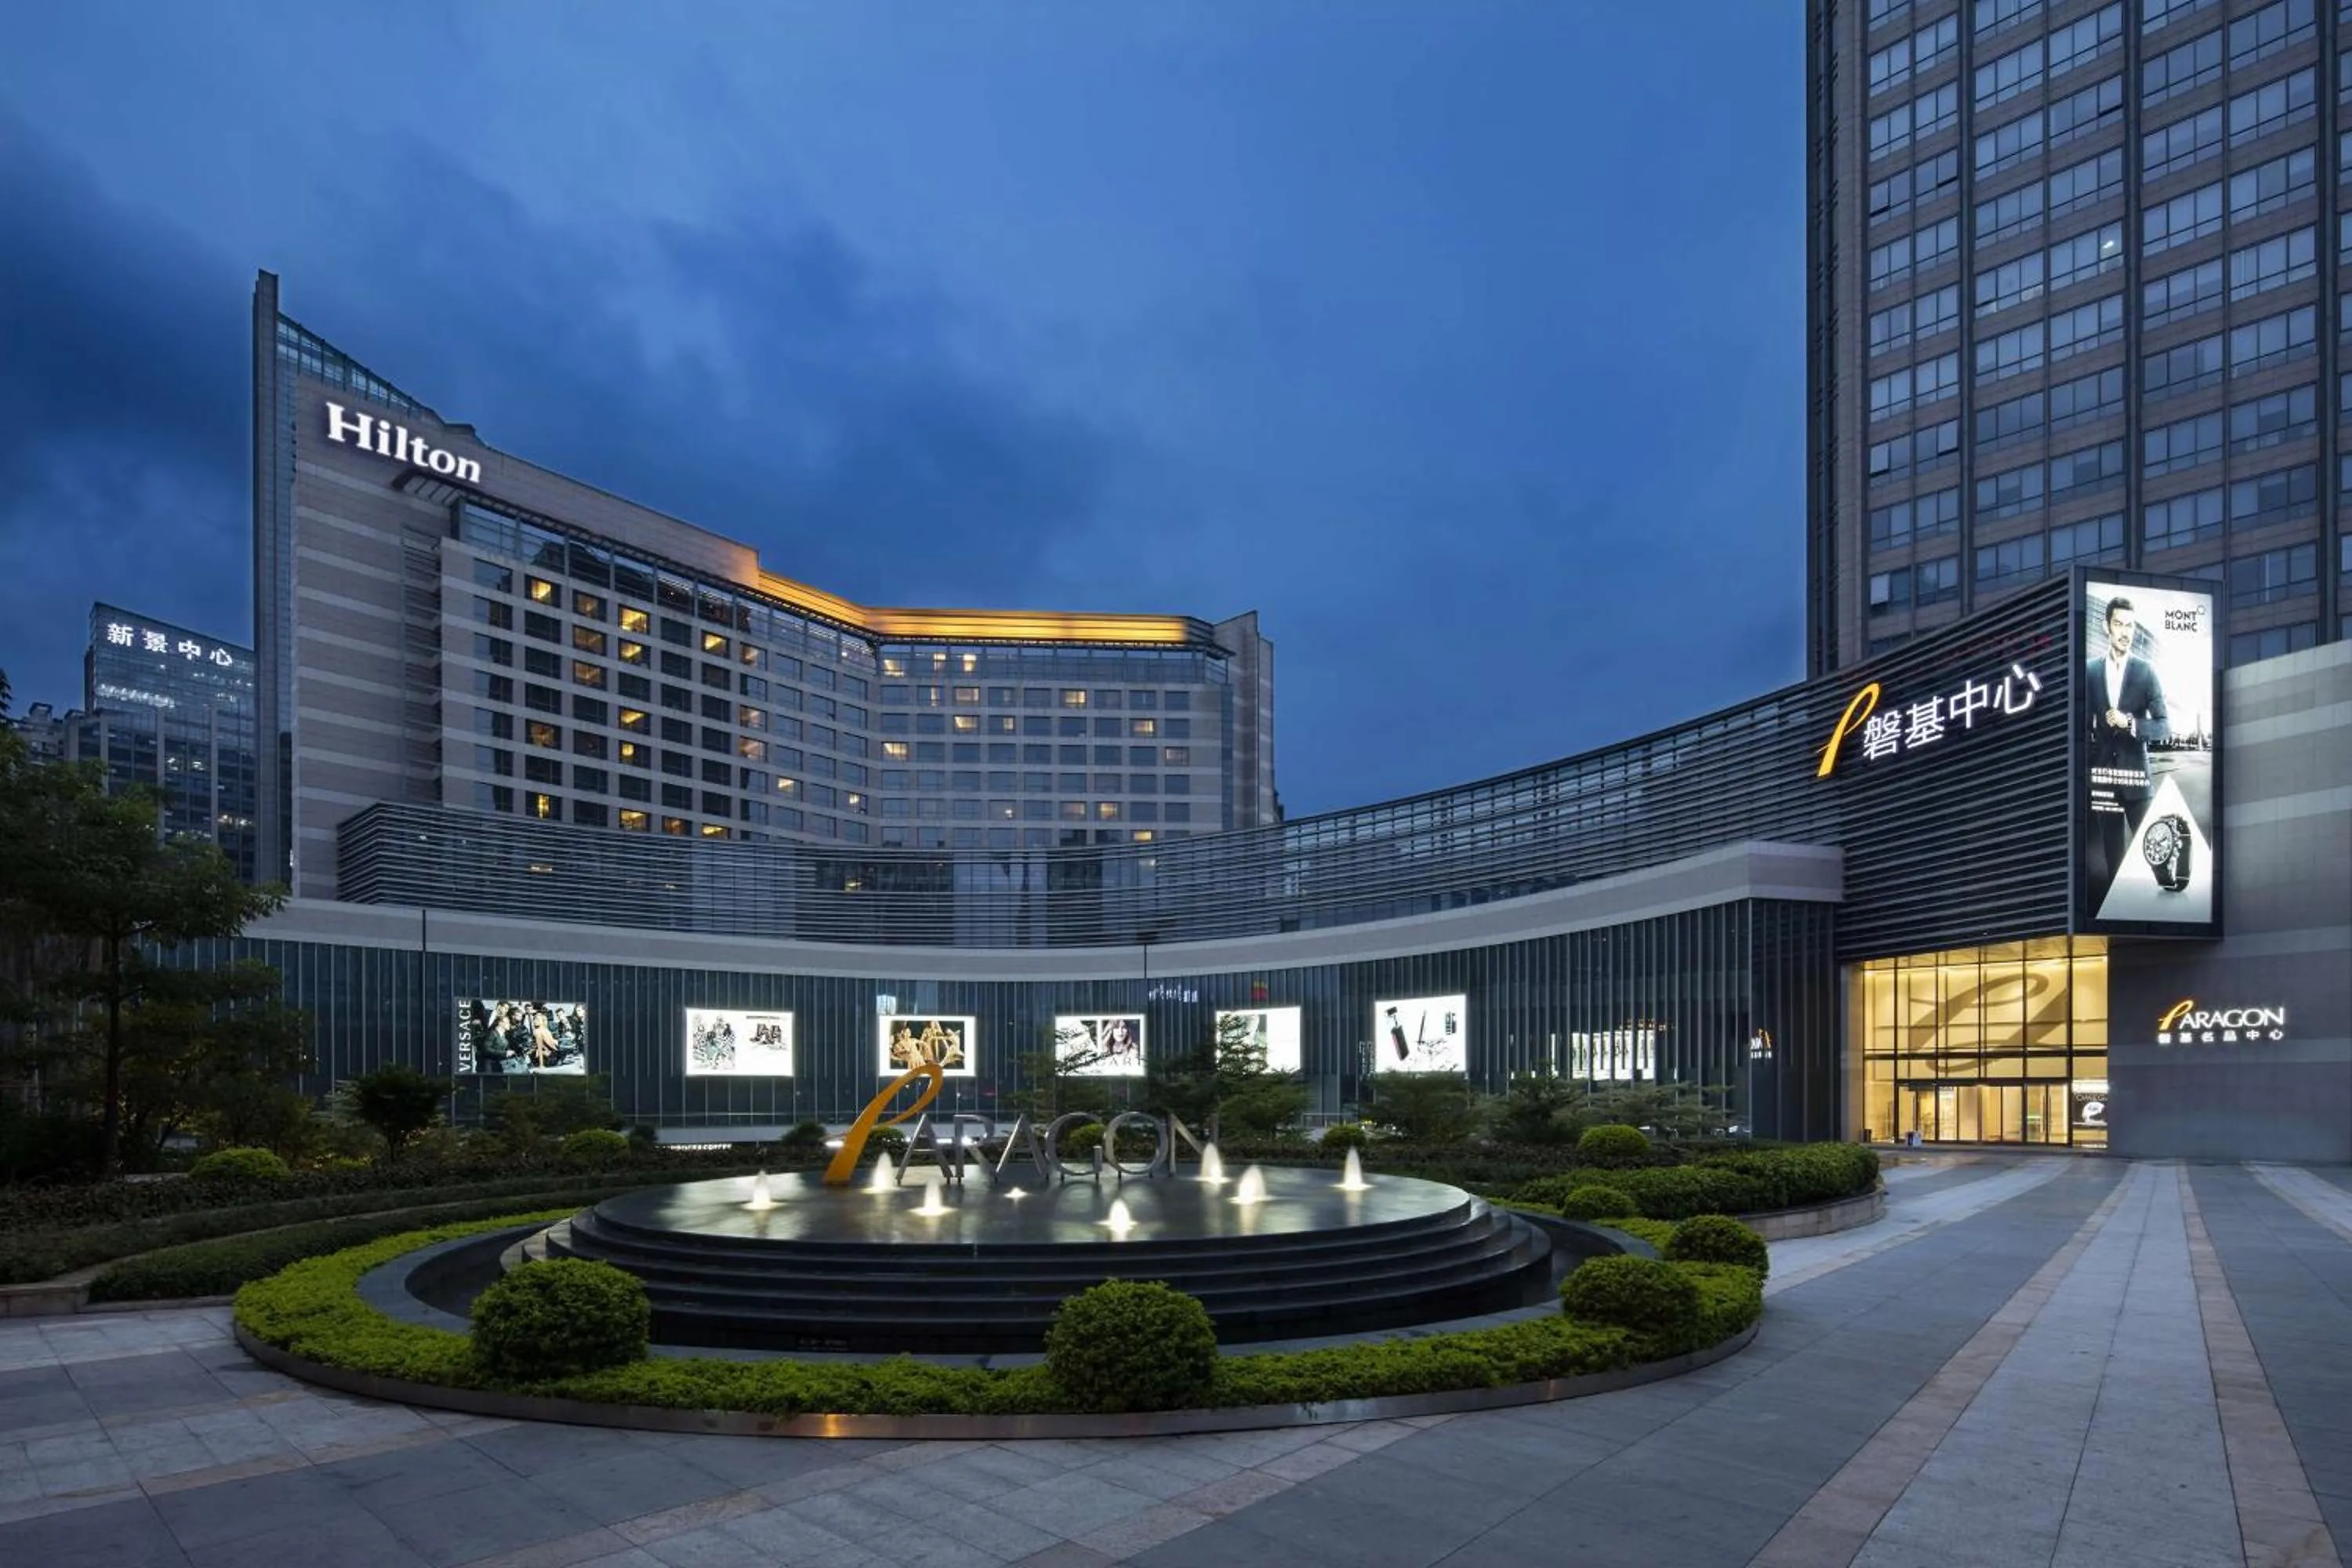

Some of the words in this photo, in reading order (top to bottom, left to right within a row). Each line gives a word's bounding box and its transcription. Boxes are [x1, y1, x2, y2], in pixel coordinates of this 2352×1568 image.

[325, 401, 481, 484] Hilton
[107, 622, 233, 666] 新景中心
[2165, 609, 2197, 621] MONT
[2165, 619, 2198, 632] BLANC
[1863, 664, 2042, 760] 磐基中心
[459, 1000, 471, 1073] VERSACE
[2158, 1000, 2285, 1030] PARAGON
[818, 1062, 1219, 1185] PARAGON
